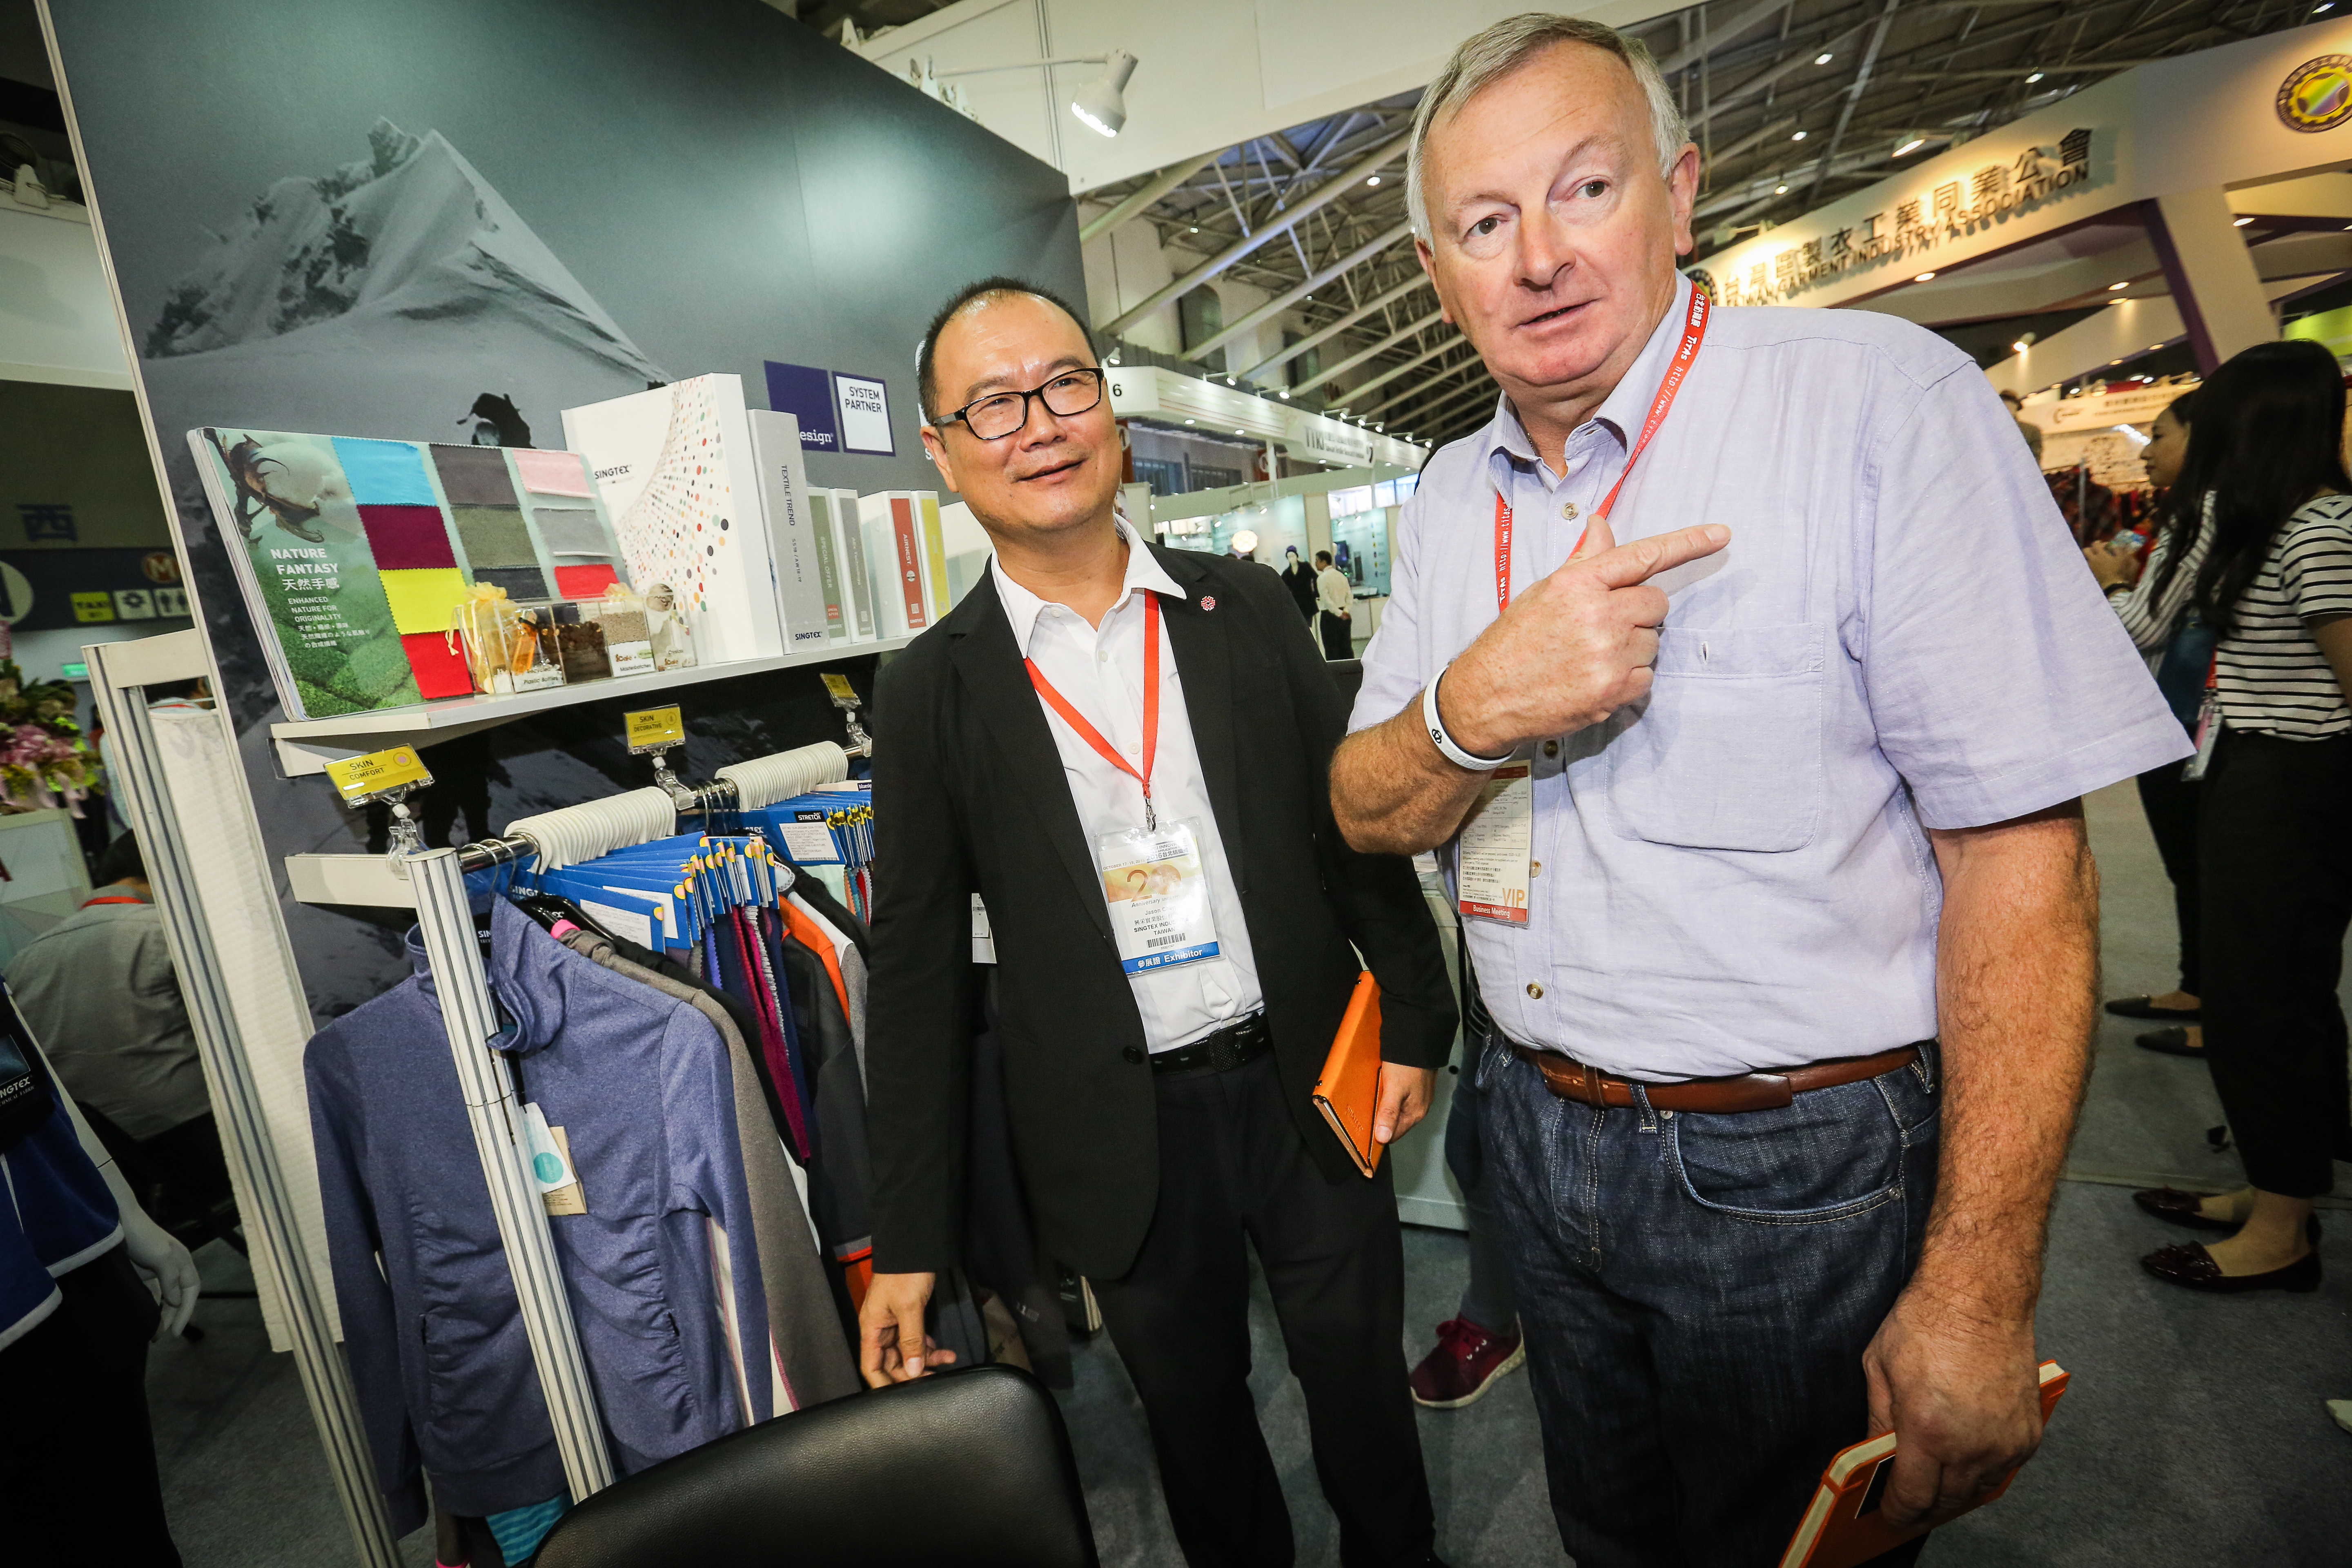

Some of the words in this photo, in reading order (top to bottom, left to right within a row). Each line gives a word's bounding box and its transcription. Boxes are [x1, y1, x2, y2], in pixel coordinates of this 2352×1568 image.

[1852, 219, 1940, 265] INDUSTRY
[1946, 160, 2089, 231] ASSOCIATION
[849, 386, 880, 401] SYSTEM
[1113, 384, 1122, 397] 6
[845, 399, 882, 413] PARTNER
[800, 429, 832, 444] esign
[595, 465, 630, 479] SINGTEX
[781, 464, 790, 497] TEXTILE
[786, 499, 795, 526] TREND
[17, 504, 78, 541] 西
[1499, 507, 1510, 572] http://www.titas
[270, 548, 327, 559] NATURE
[903, 534, 912, 565] AIRNEST
[276, 563, 339, 575] FANTASY
[282, 577, 340, 591] 天然手感
[288, 596, 328, 605] ENHANCED
[291, 605, 322, 613] NATURE
[294, 614, 342, 623] ORIGINALITY
[795, 631, 821, 641] SINGTEX
[634, 723, 662, 732] DECORATIVE
[350, 759, 374, 771] SKIN
[349, 767, 385, 780] COMFORT
[1131, 898, 1160, 908] Anniversary
[1502, 888, 1525, 909] VIP
[1473, 904, 1490, 914] Business
[1491, 907, 1510, 919] Meeting
[1134, 924, 1158, 933] SINGTEX
[1138, 956, 1161, 968] 參展證
[1164, 949, 1203, 963] Exhibitor
